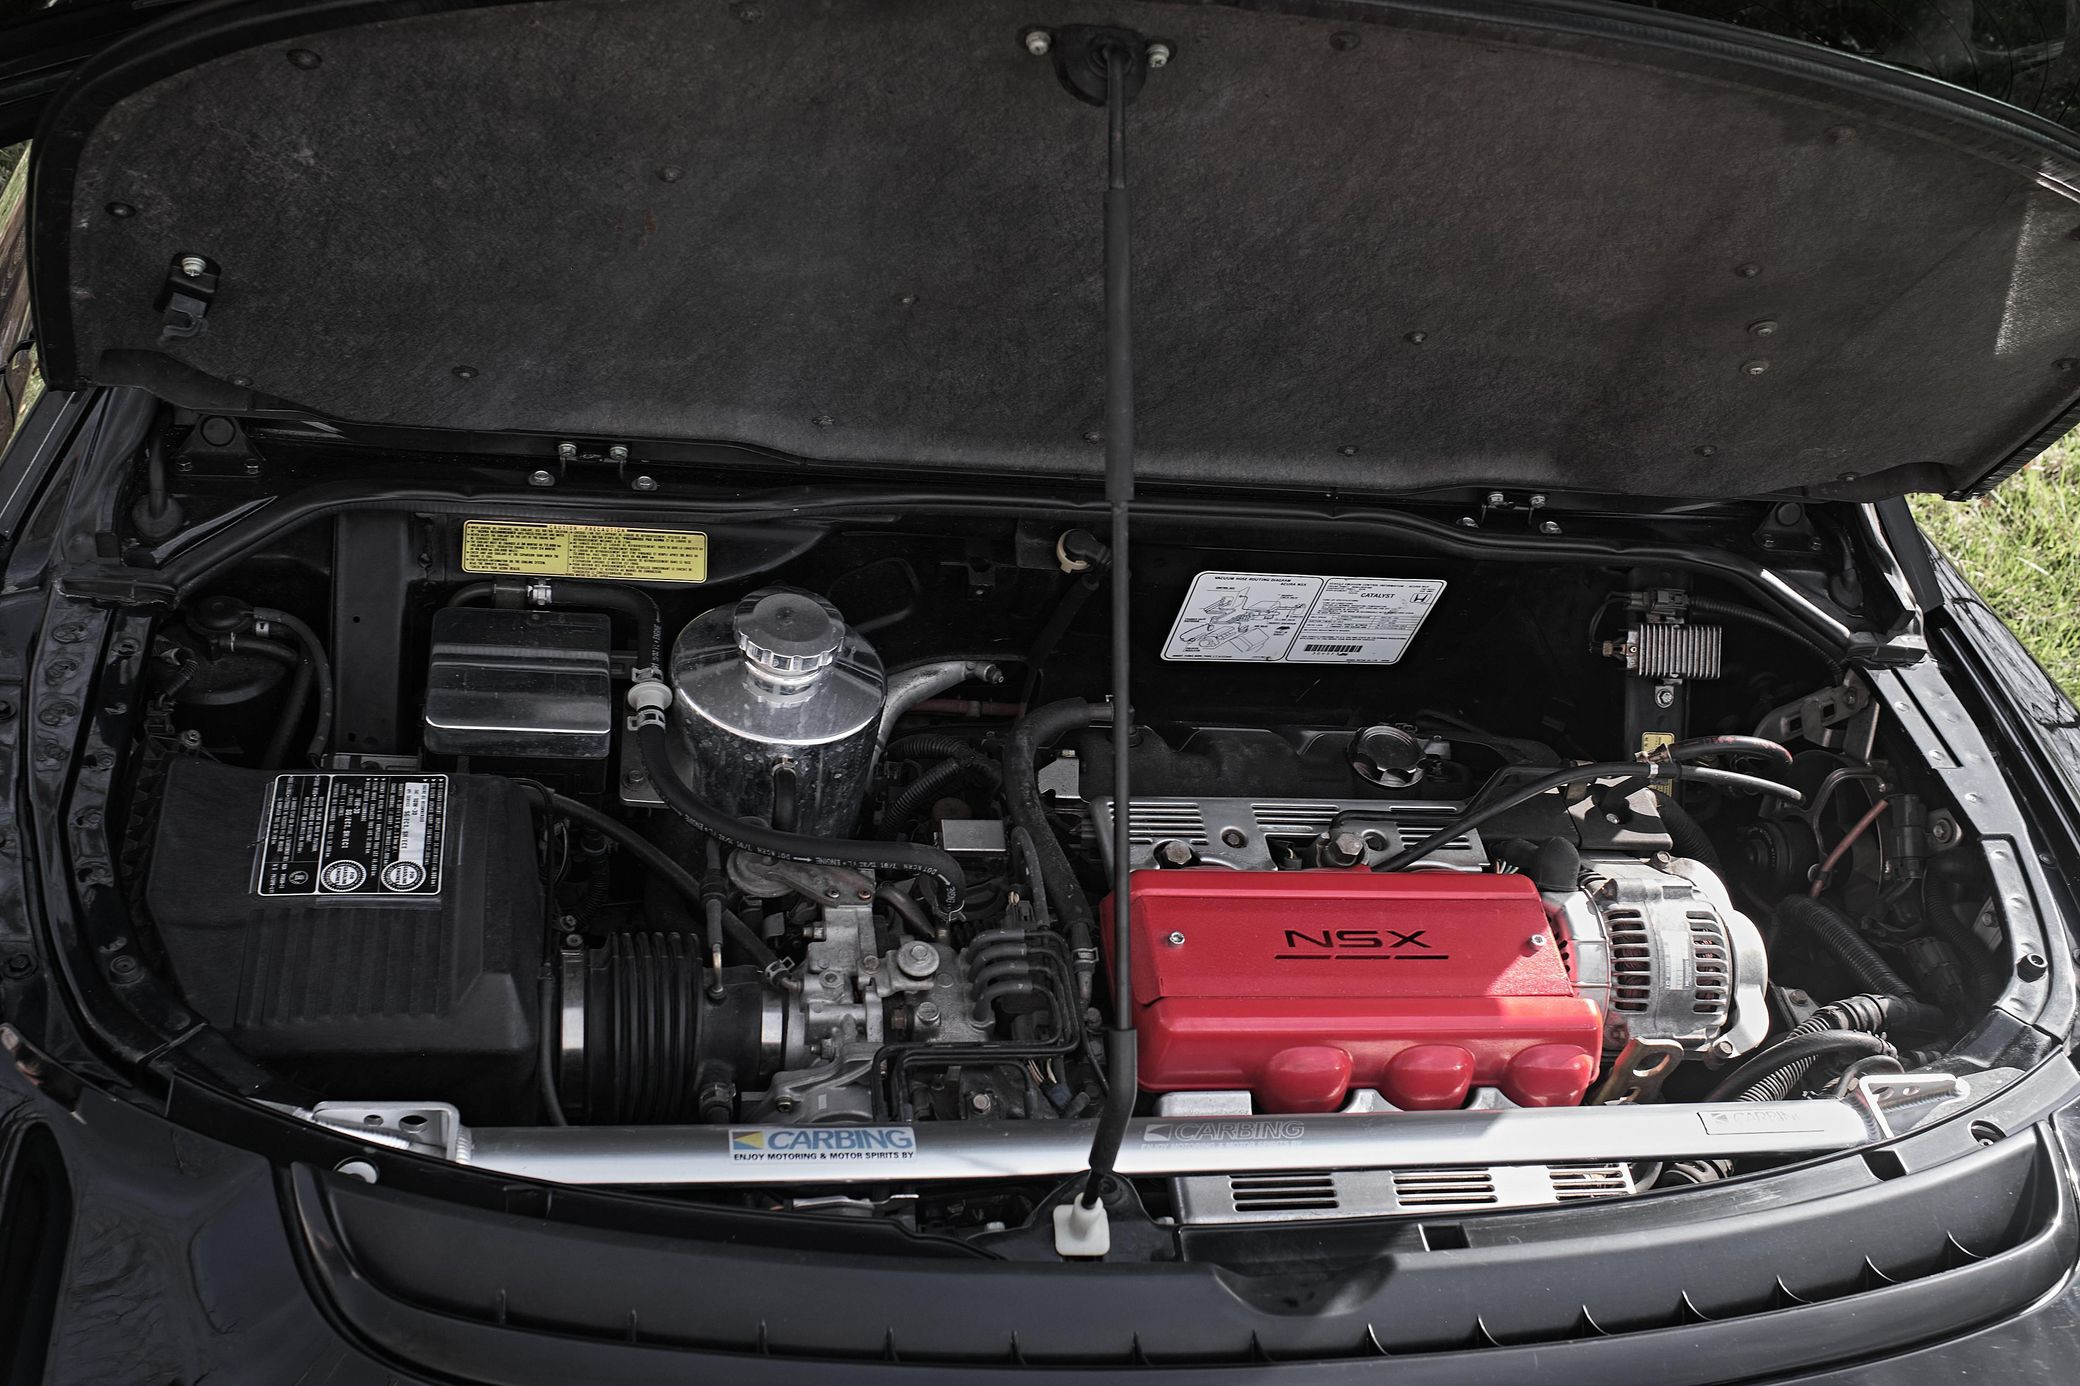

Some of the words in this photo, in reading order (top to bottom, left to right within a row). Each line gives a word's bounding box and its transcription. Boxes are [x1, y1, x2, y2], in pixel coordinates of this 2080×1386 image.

[1284, 930, 1432, 948] NSX
[767, 1129, 913, 1150] CARBING
[1174, 1120, 1305, 1141] CARBING
[734, 1153, 764, 1161] ENJOY
[767, 1152, 817, 1160] MOTORING
[819, 1152, 826, 1160] &
[829, 1152, 863, 1160] MOTOR
[865, 1151, 899, 1159] SPIRITS
[901, 1151, 914, 1159] BY
